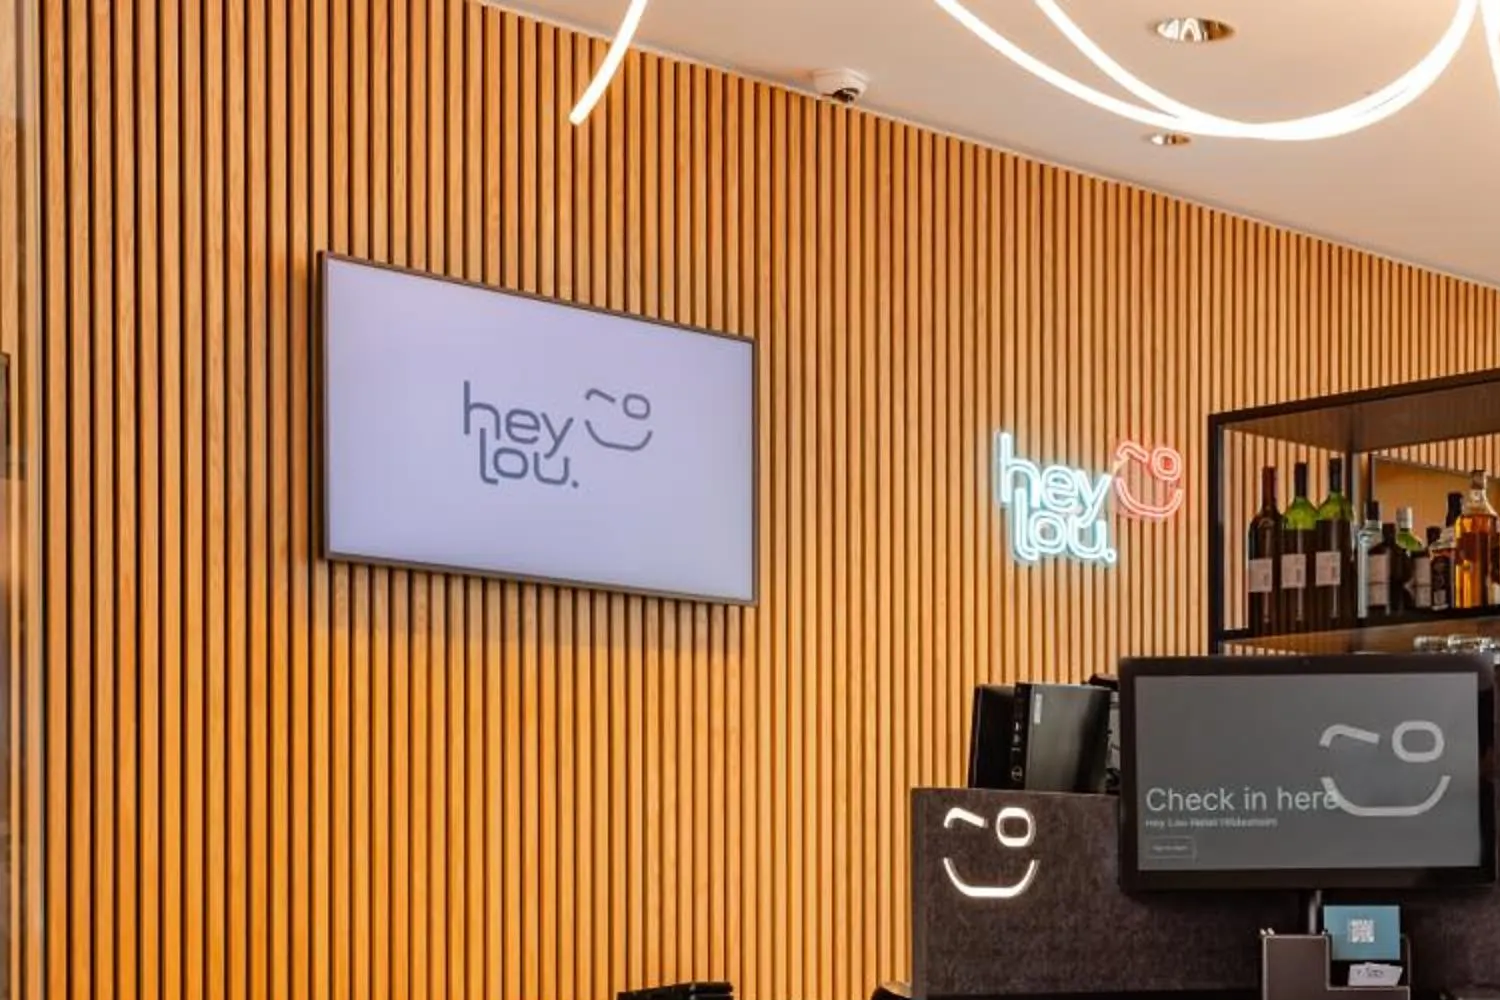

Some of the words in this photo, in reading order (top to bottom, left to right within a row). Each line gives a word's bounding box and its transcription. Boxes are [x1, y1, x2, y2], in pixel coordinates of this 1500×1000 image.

[463, 380, 574, 458] hey
[479, 427, 579, 488] lou.
[996, 431, 1113, 528] hey
[1014, 487, 1117, 563] lou.
[1145, 786, 1236, 811] Check
[1244, 786, 1267, 811] in
[1276, 786, 1339, 811] here
